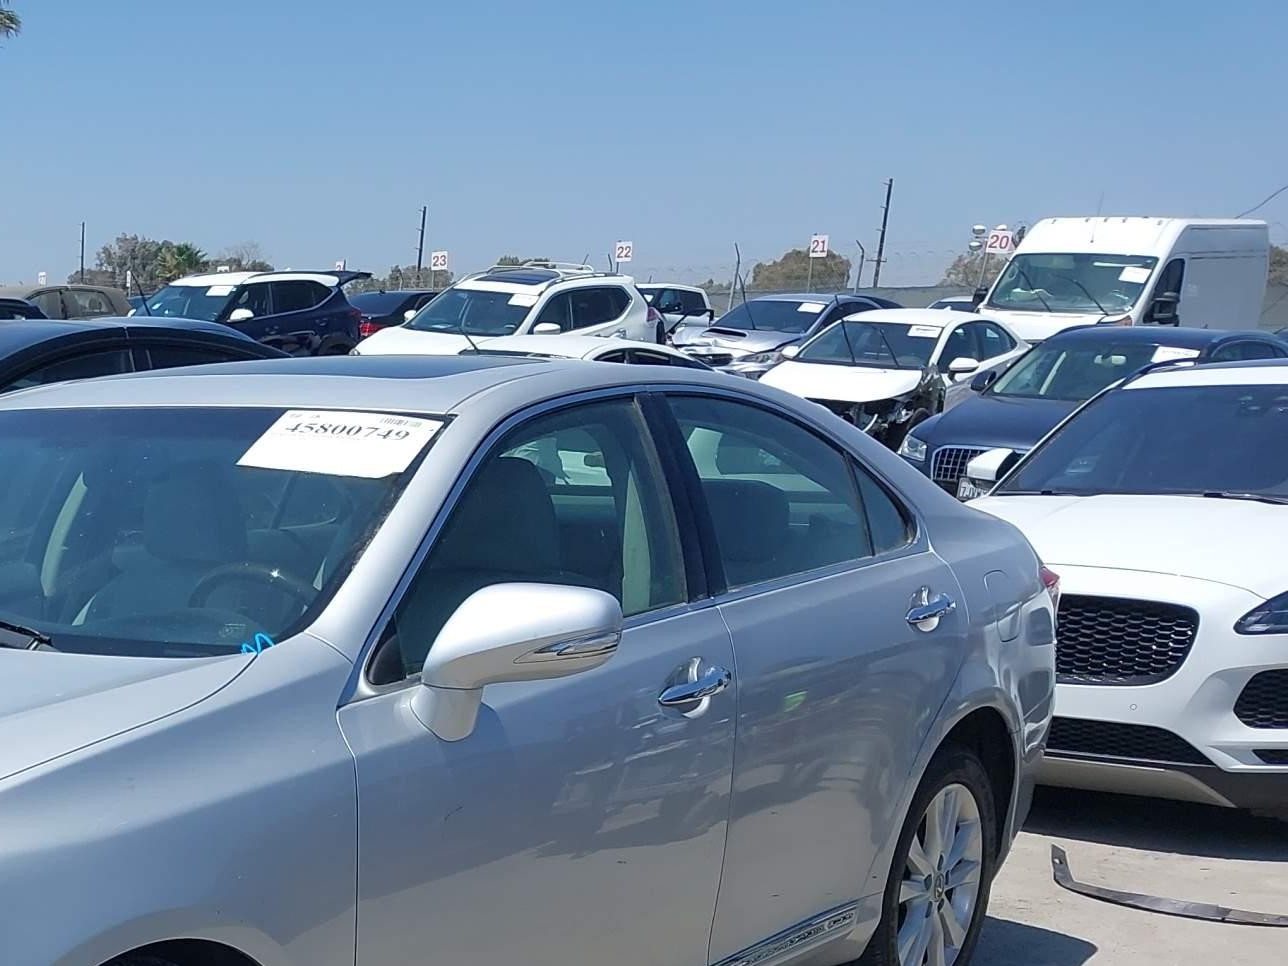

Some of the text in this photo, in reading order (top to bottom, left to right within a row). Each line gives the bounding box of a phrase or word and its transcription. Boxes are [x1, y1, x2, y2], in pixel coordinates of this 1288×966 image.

[811, 239, 826, 253] 21
[988, 234, 1010, 250] 20
[616, 245, 632, 259] 22
[432, 254, 447, 267] 23
[285, 422, 410, 441] 45800749
